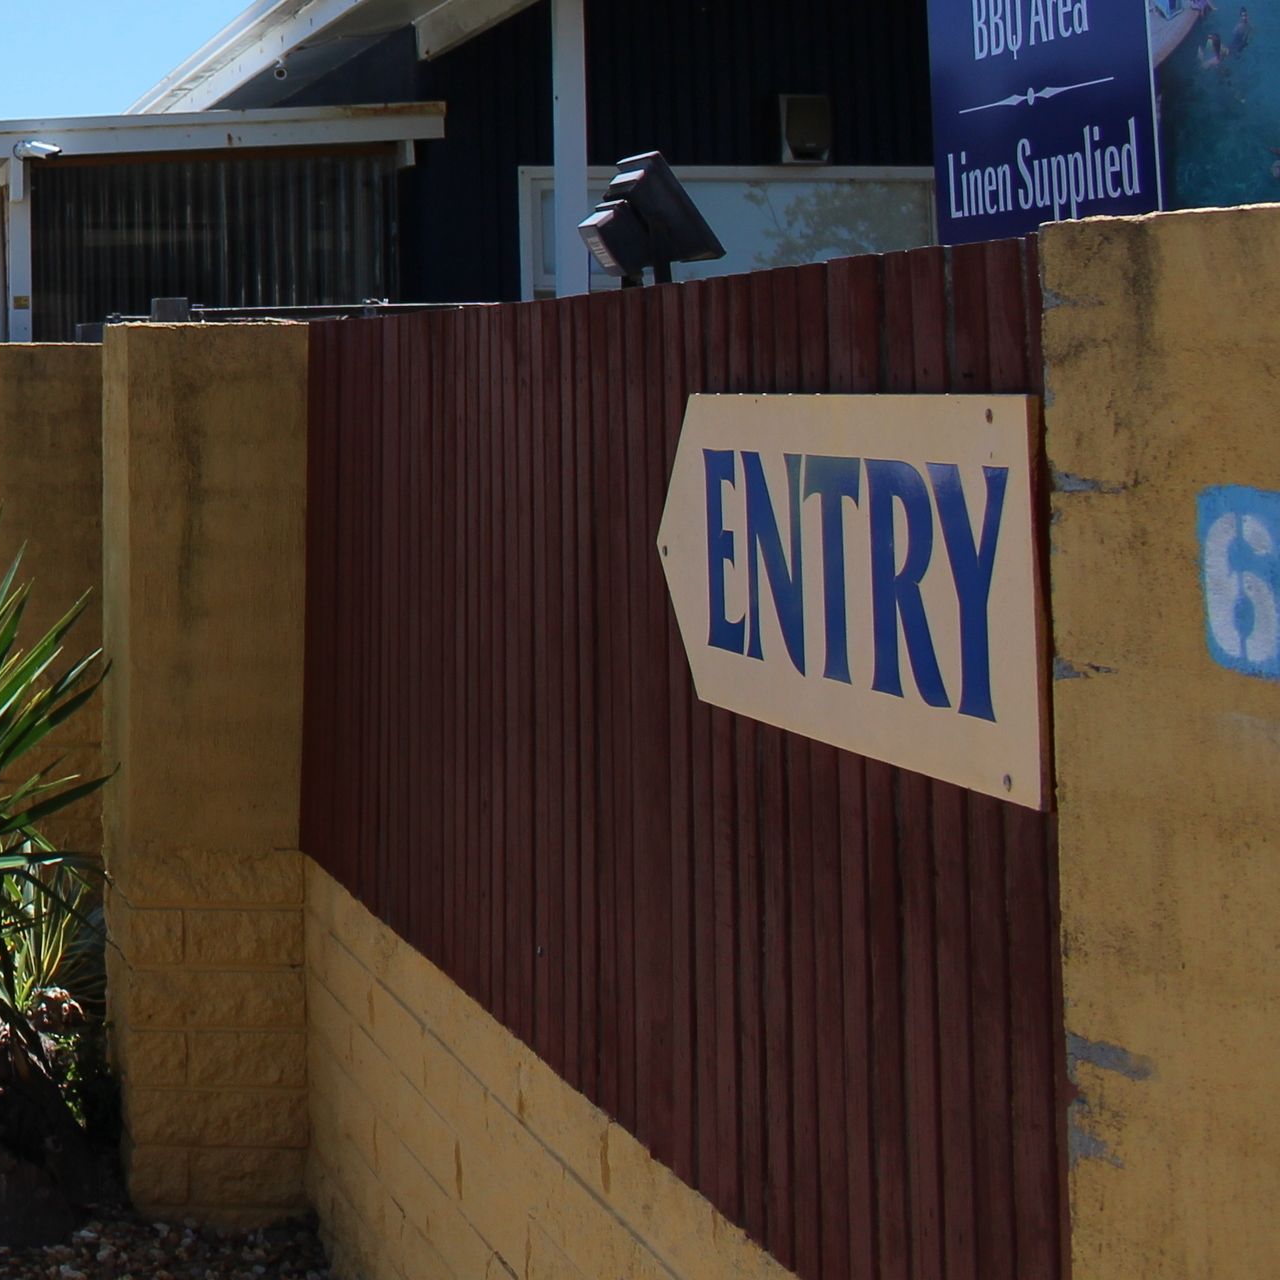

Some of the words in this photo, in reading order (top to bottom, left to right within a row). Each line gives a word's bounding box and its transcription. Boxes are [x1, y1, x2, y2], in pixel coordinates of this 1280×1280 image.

[947, 151, 1013, 218] Linen
[1016, 116, 1140, 223] Supplied
[702, 448, 1009, 724] ENTRY
